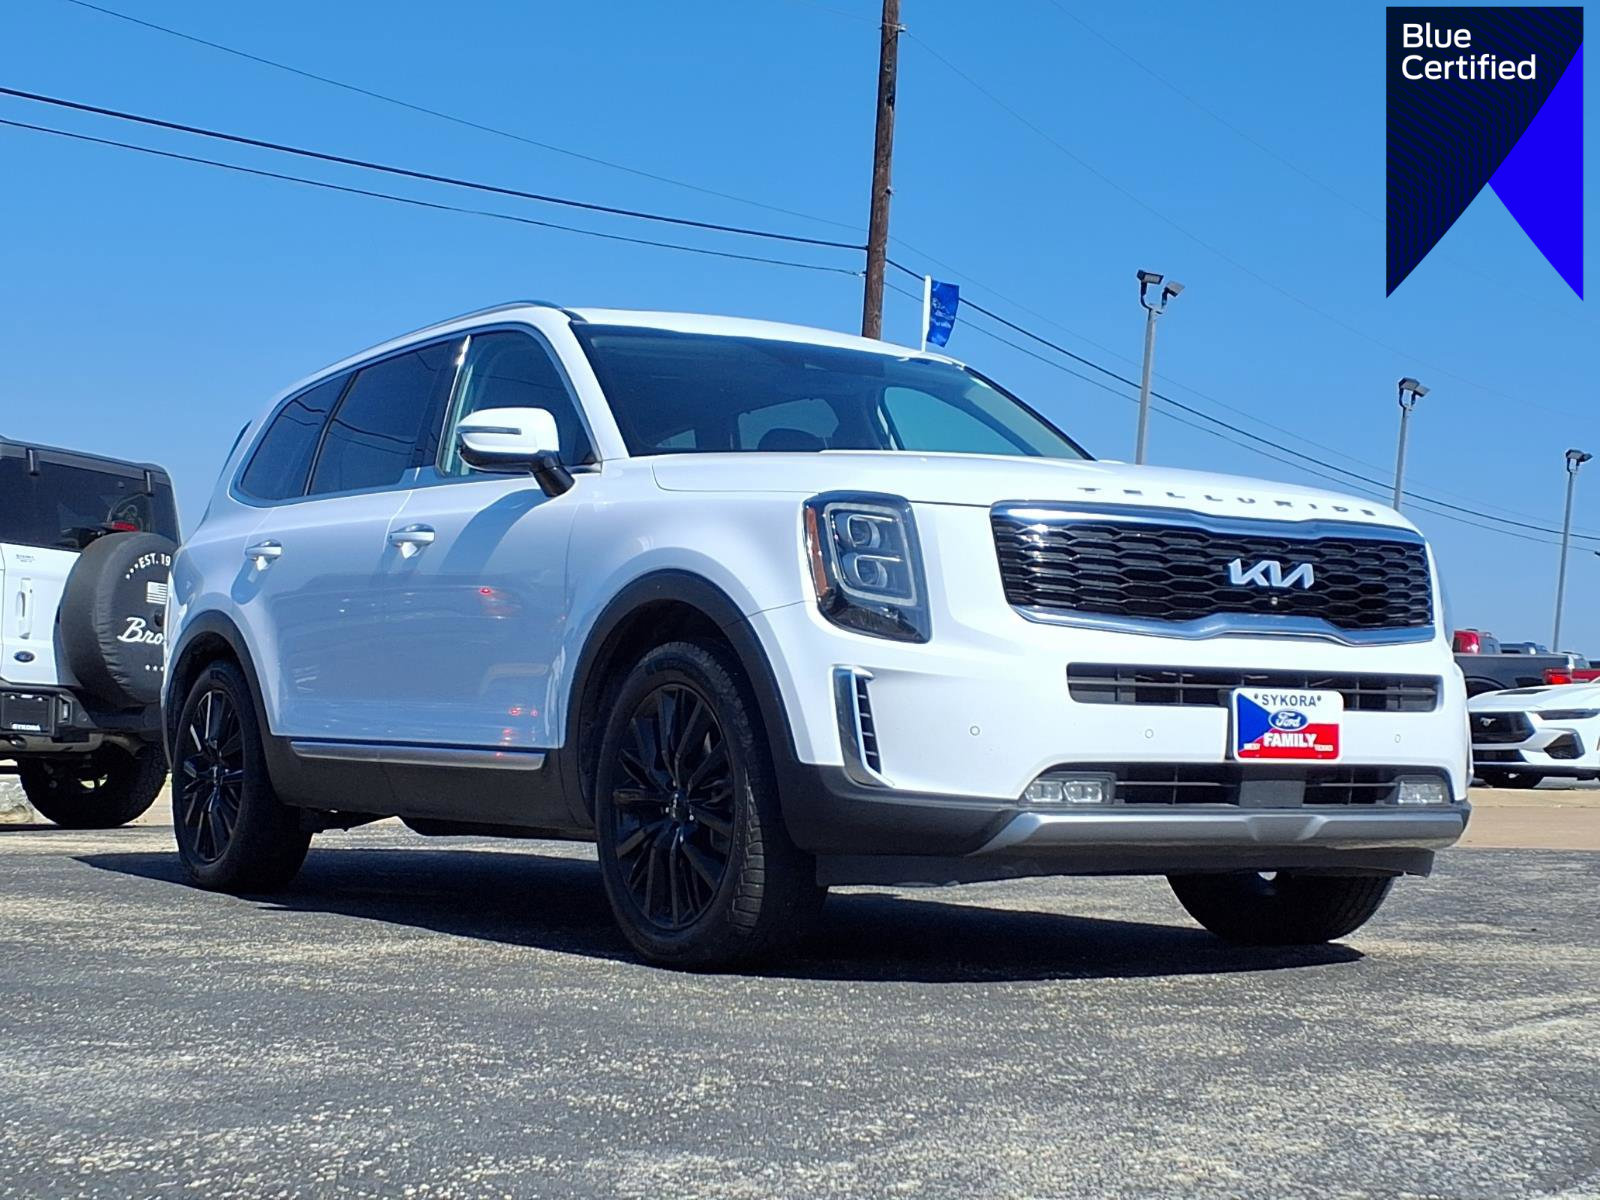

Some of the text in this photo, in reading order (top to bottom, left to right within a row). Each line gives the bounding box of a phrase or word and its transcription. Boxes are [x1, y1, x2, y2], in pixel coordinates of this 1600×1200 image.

[138, 553, 171, 569] EST. 19
[1228, 558, 1315, 589] KIA
[117, 616, 165, 645] Bro
[1262, 694, 1317, 707] SYKORA
[1275, 711, 1302, 727] Ford
[1263, 732, 1317, 748] FAMILY
